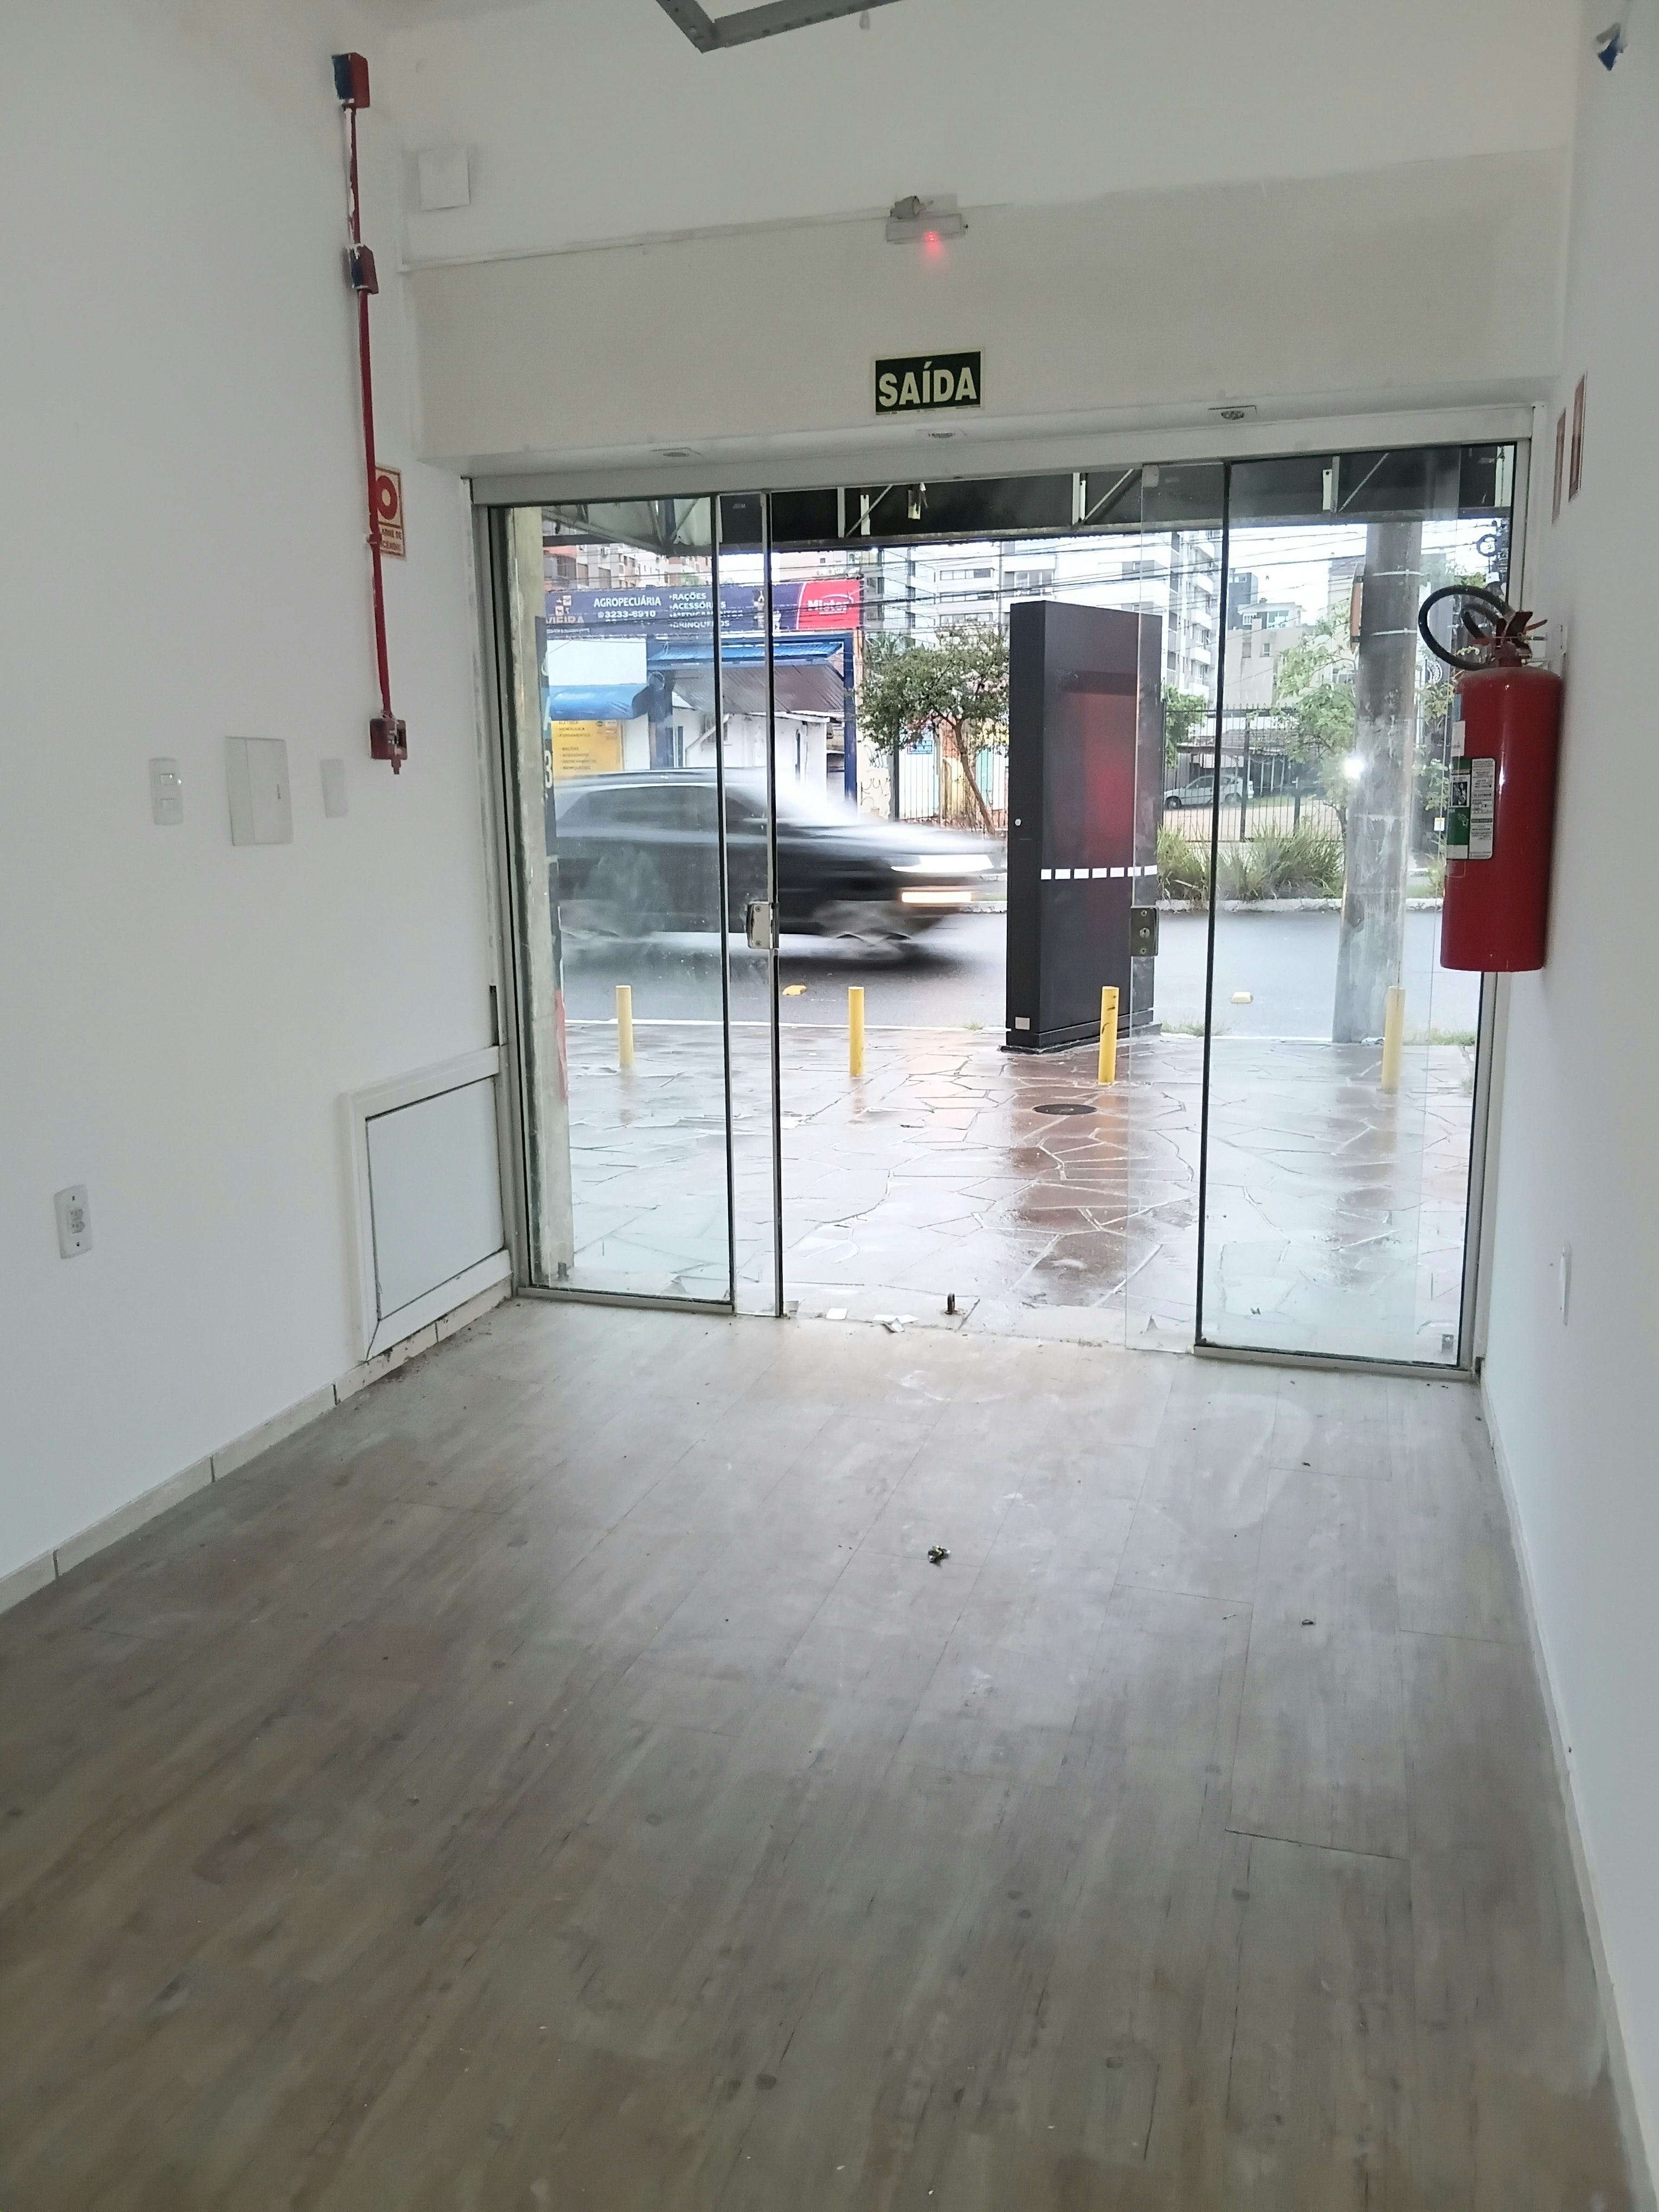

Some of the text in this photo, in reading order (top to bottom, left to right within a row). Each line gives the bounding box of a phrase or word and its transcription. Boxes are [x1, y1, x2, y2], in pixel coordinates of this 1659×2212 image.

[879, 361, 977, 407] SAÍDA
[594, 595, 661, 607] AGROPECUÁRIA
[672, 592, 706, 601] RAÇÕES
